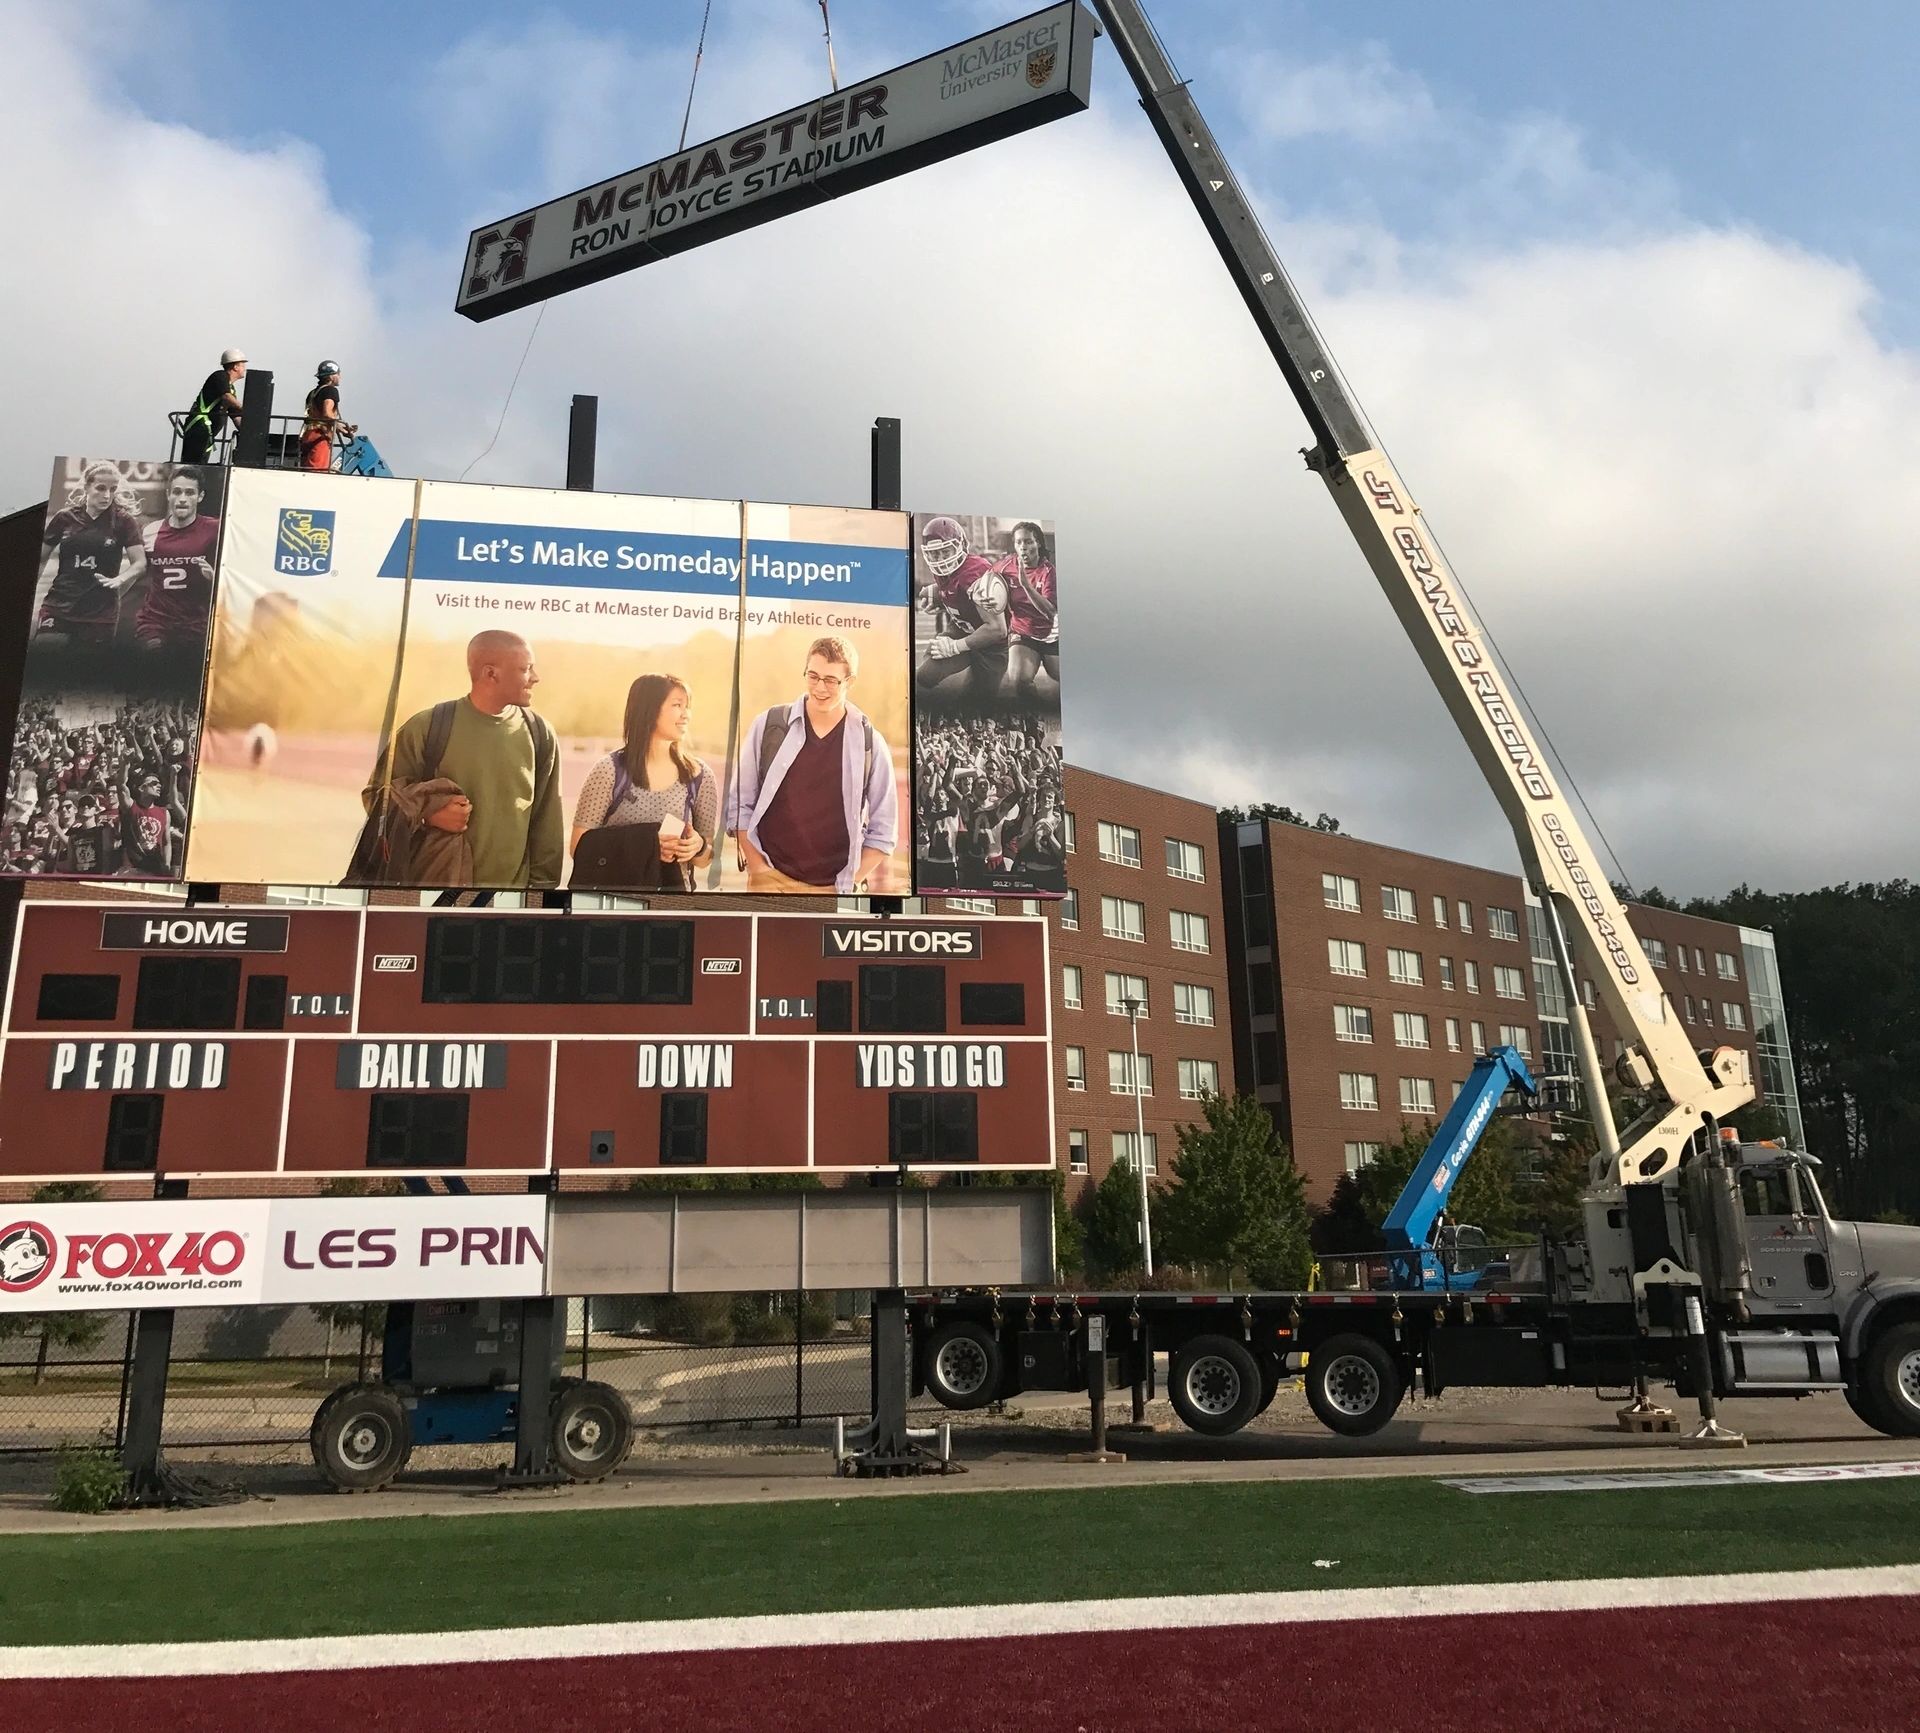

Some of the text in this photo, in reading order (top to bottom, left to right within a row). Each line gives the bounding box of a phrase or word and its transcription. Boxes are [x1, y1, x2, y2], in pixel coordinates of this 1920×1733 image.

[940, 22, 1060, 84] McMaster
[941, 60, 1021, 100] University
[573, 85, 888, 231] McMASTER
[570, 125, 885, 259] RON JOYCE STADIUM
[1210, 180, 1224, 191] A
[1261, 272, 1274, 284] B
[1312, 369, 1325, 382] C
[74, 555, 97, 570] 14
[163, 568, 187, 590] 2
[280, 555, 326, 572] RBC
[532, 541, 609, 568] Make
[616, 546, 741, 582] Someday
[436, 593, 871, 629] Visit the new RBC at McMaster David Braley Athletic Centre
[1364, 471, 1553, 800] JT CRANE & RIGGING
[1542, 813, 1638, 984] 905.658.4499
[144, 920, 248, 945] HOME
[831, 929, 973, 953] VISITORS
[52, 1042, 225, 1090] PERIOD
[359, 1043, 485, 1089] BALL ON
[637, 1044, 733, 1088] DOWN
[858, 1044, 1004, 1088] YDS TO GO
[283, 1226, 544, 1270] LES PRIN
[58, 1278, 243, 1294] www.fox40world.com
